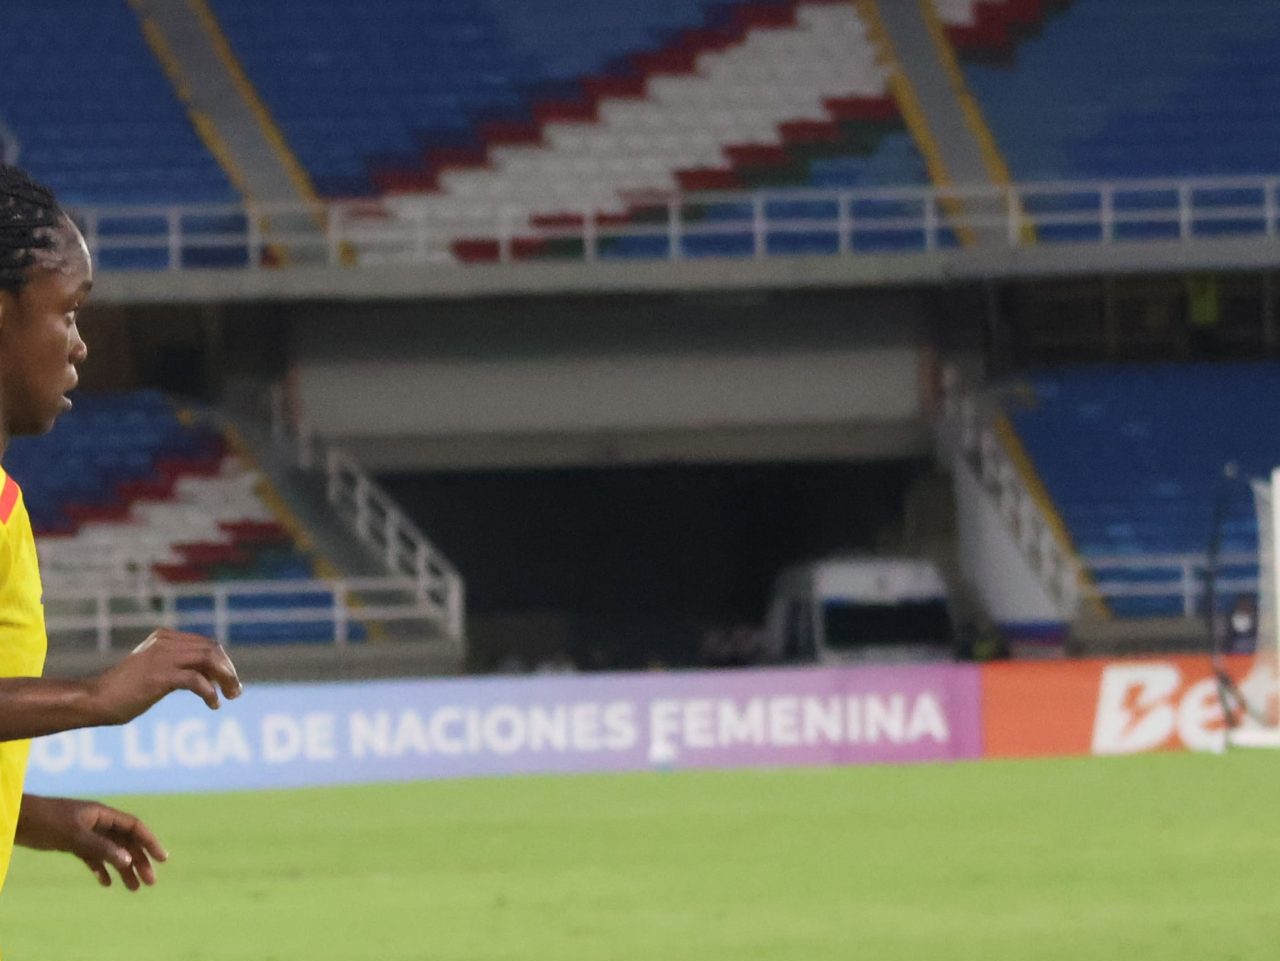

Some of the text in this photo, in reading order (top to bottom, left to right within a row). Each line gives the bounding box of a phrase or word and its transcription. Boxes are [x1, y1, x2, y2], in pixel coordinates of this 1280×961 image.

[122, 717, 251, 769] LIGA
[260, 712, 336, 764] DE
[350, 702, 640, 757] NACIONES
[649, 692, 950, 750] FEMENINA
